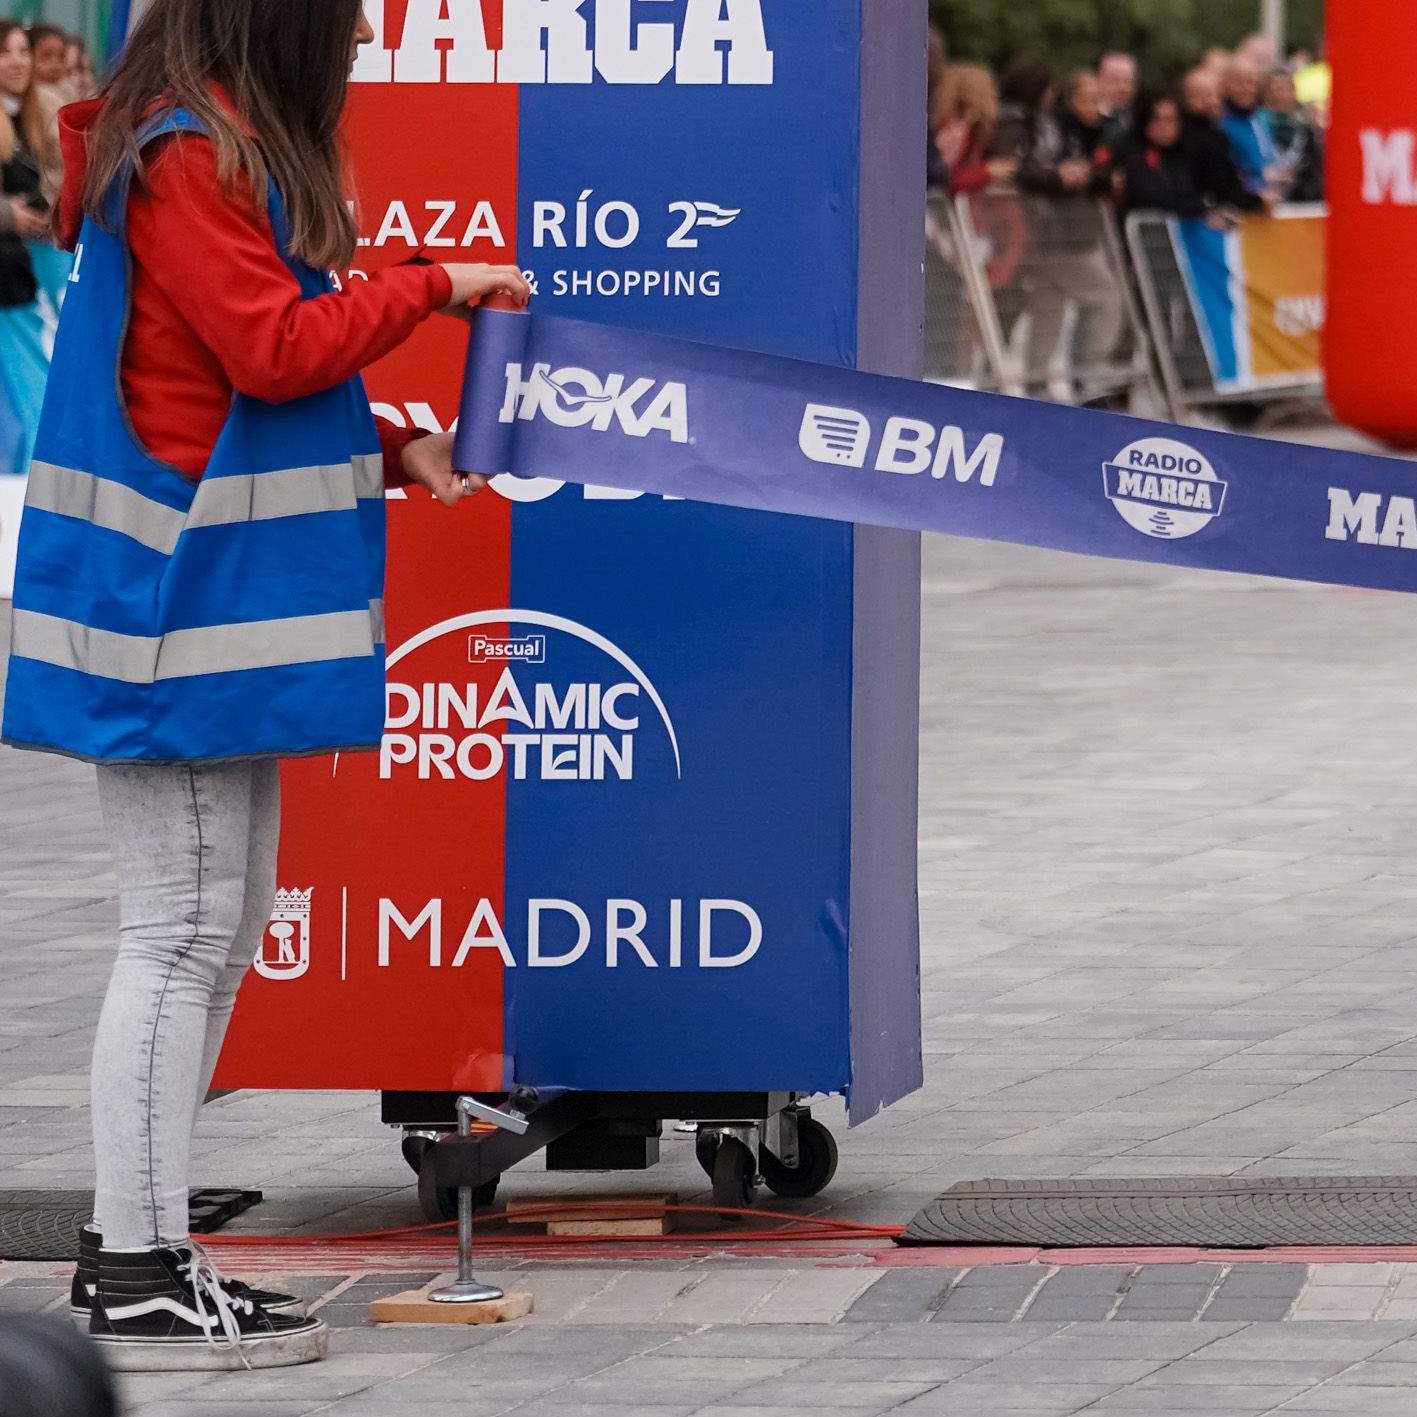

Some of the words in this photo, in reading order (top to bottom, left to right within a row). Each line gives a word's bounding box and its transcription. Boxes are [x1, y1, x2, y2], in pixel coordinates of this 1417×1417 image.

[532, 190, 640, 249] RÍO
[666, 201, 700, 249] 2
[552, 268, 721, 298] SHOPPING
[874, 415, 1005, 487] BM
[1128, 449, 1204, 476] RADIO
[1117, 470, 1214, 510] MARCA
[474, 639, 540, 656] Pascual
[379, 733, 633, 780] PROTEIN
[377, 898, 763, 968] MADRID
